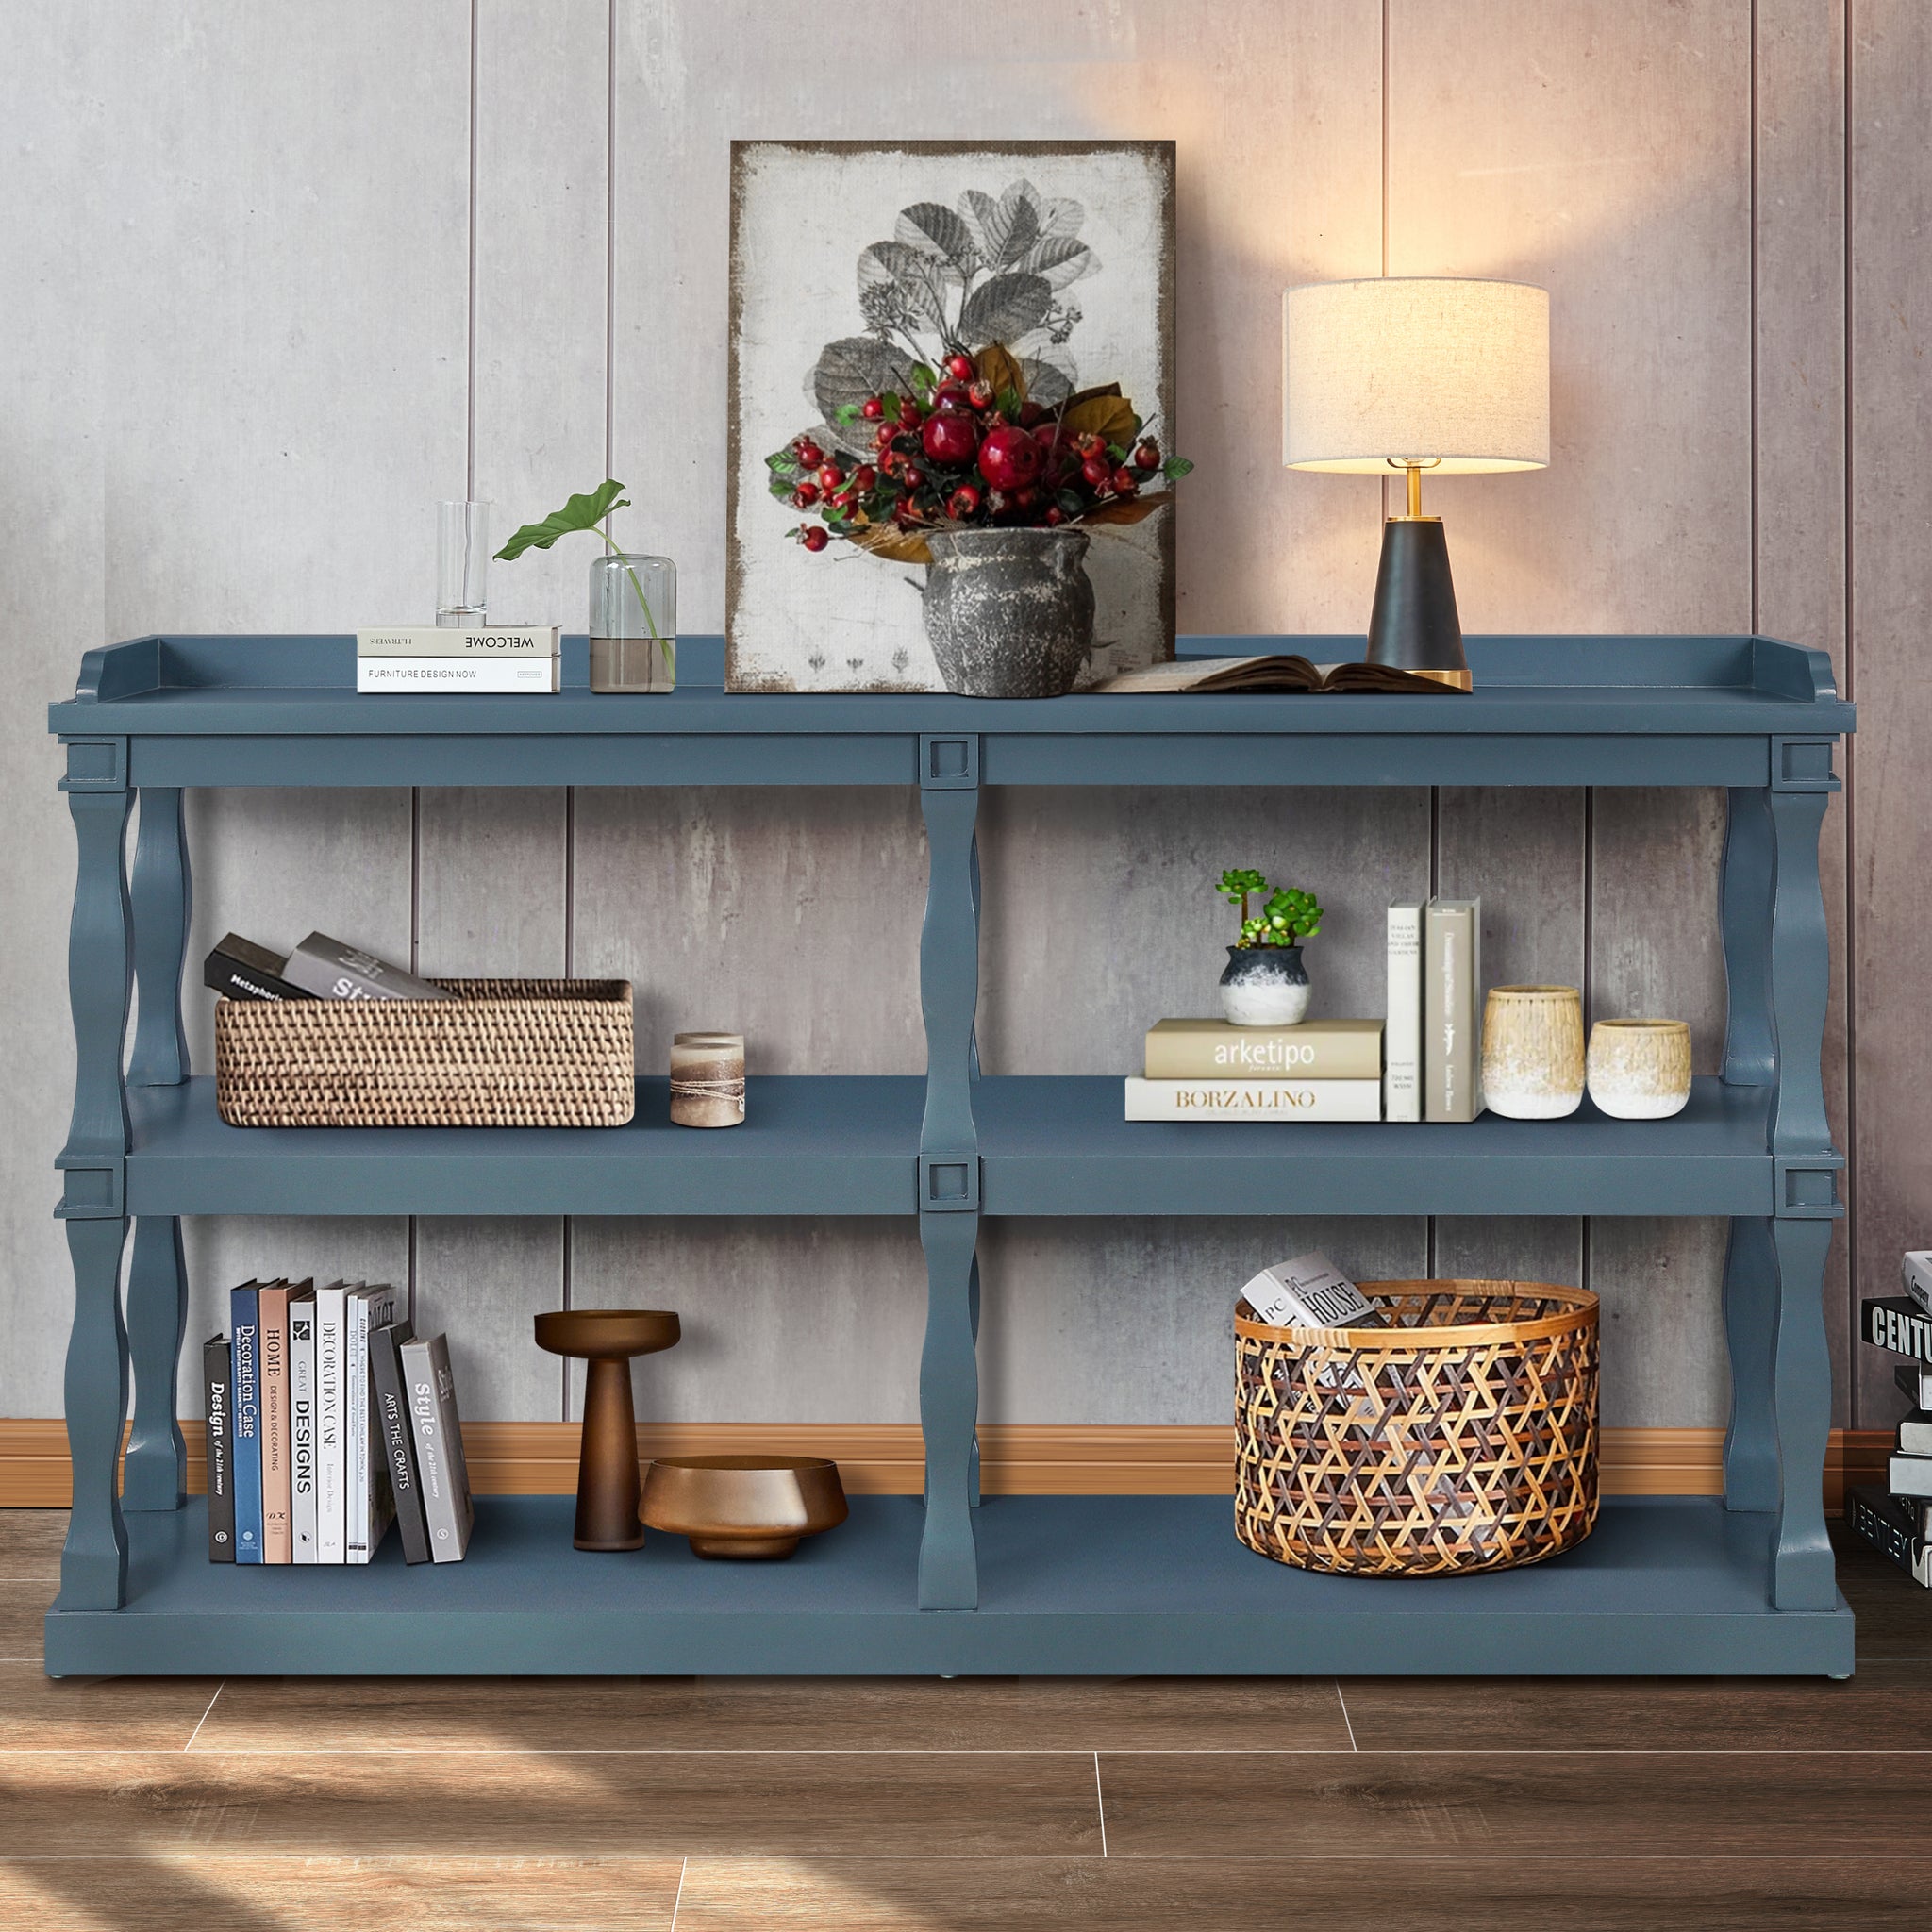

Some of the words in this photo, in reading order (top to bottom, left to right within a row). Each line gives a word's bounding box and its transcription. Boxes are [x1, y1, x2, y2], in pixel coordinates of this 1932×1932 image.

[465, 637, 534, 648] WELCOME
[368, 670, 419, 678] FURNITURE
[421, 670, 454, 678] DESIGN
[456, 670, 477, 678] NOW
[1214, 1039, 1315, 1071] arketipo
[1176, 1090, 1315, 1108] BORZALINO
[1265, 1297, 1287, 1320] PC
[1301, 1282, 1364, 1324] HOUSE
[241, 1325, 256, 1400] Decoration
[267, 1329, 281, 1377] HOME
[321, 1322, 337, 1412] DECORATION
[298, 1361, 308, 1392] GREAT
[209, 1382, 226, 1437] Design
[270, 1386, 279, 1413] DESIGN
[384, 1392, 398, 1421] ARTS
[415, 1383, 435, 1436] Style
[243, 1403, 258, 1438] Case
[323, 1415, 337, 1450] CASE
[390, 1424, 403, 1445] THE
[271, 1422, 279, 1471] DECORATING
[295, 1401, 311, 1493] DESIGNS
[393, 1449, 409, 1490] CRAFTS
[1860, 1504, 1907, 1563] BENTLEY
